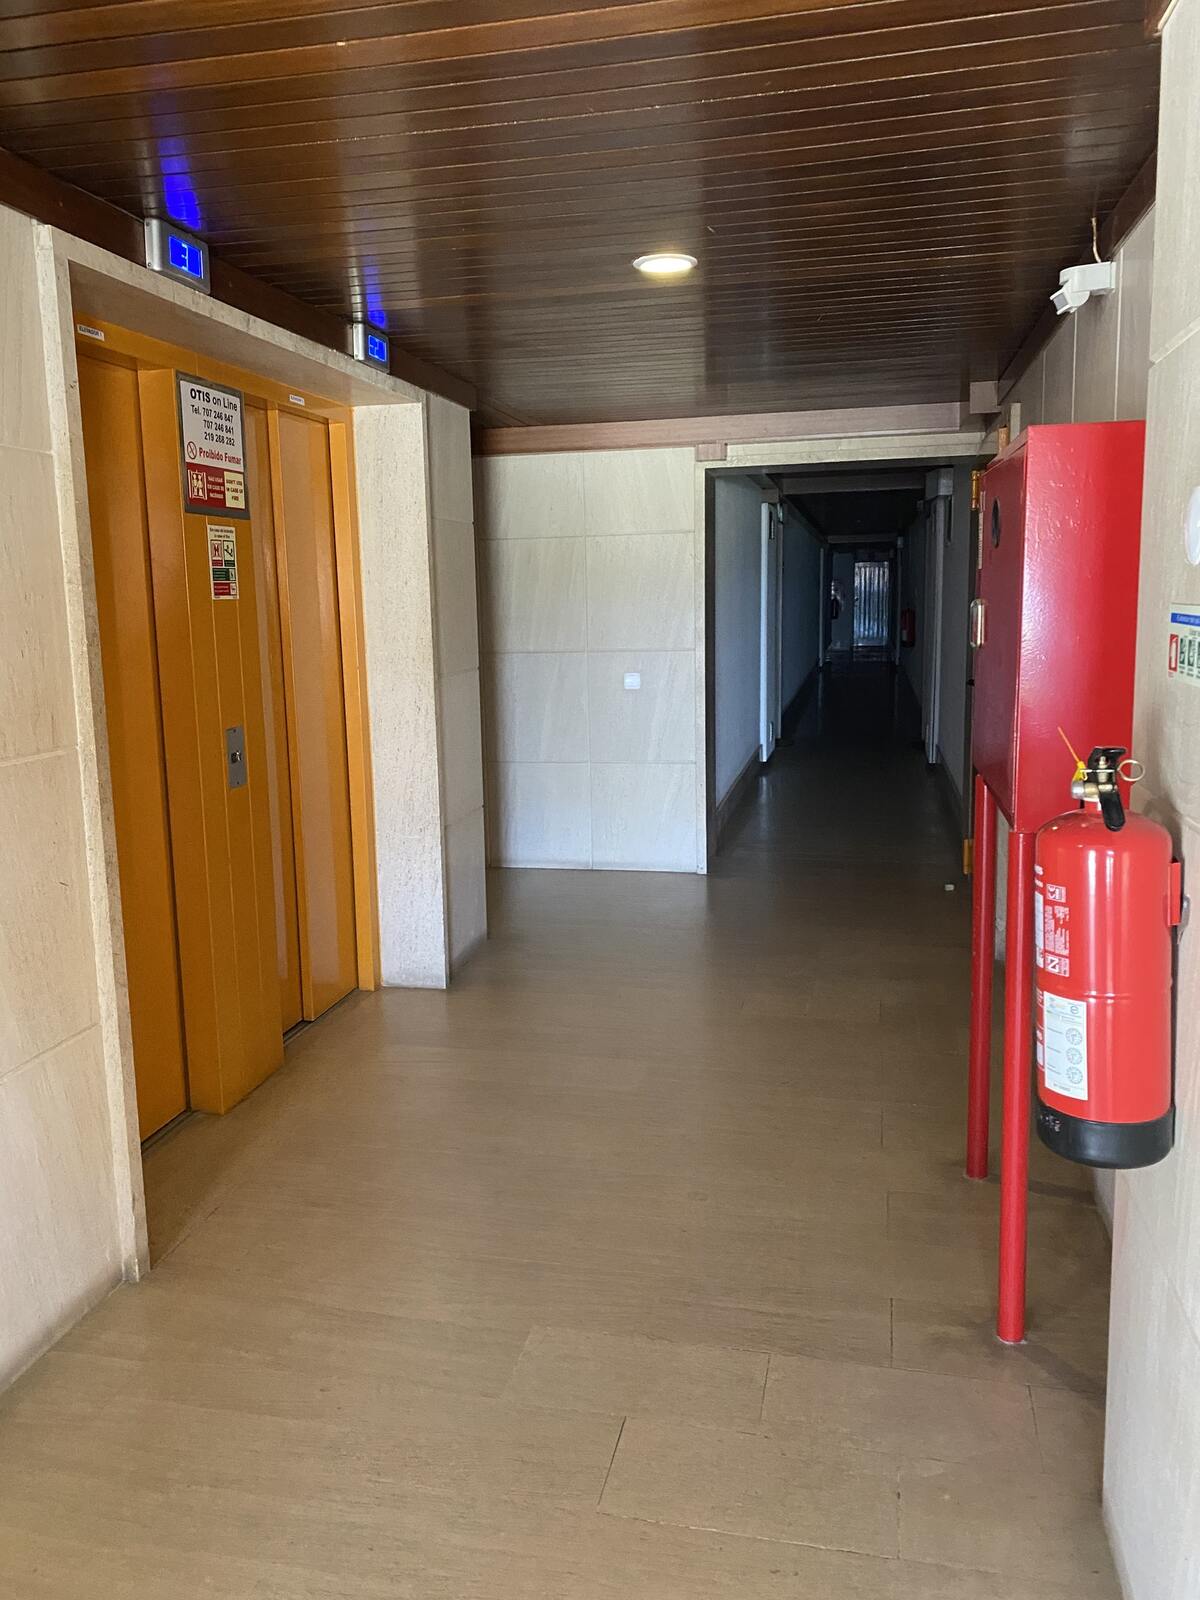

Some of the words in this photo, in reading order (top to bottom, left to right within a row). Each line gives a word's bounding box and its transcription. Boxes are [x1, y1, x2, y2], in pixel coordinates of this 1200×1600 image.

[181, 242, 189, 272] 3
[190, 388, 211, 404] OTIS
[212, 397, 222, 407] on
[223, 397, 238, 412] Line
[190, 404, 201, 415] Tel.
[202, 407, 213, 418] 707
[213, 411, 224, 421] 246
[224, 413, 234, 423] 847
[203, 420, 213, 430] 707
[214, 423, 224, 433] 246
[225, 425, 234, 435] 841
[204, 432, 214, 442] 219
[199, 447, 223, 461] Proibido
[224, 453, 242, 465] Fumar
